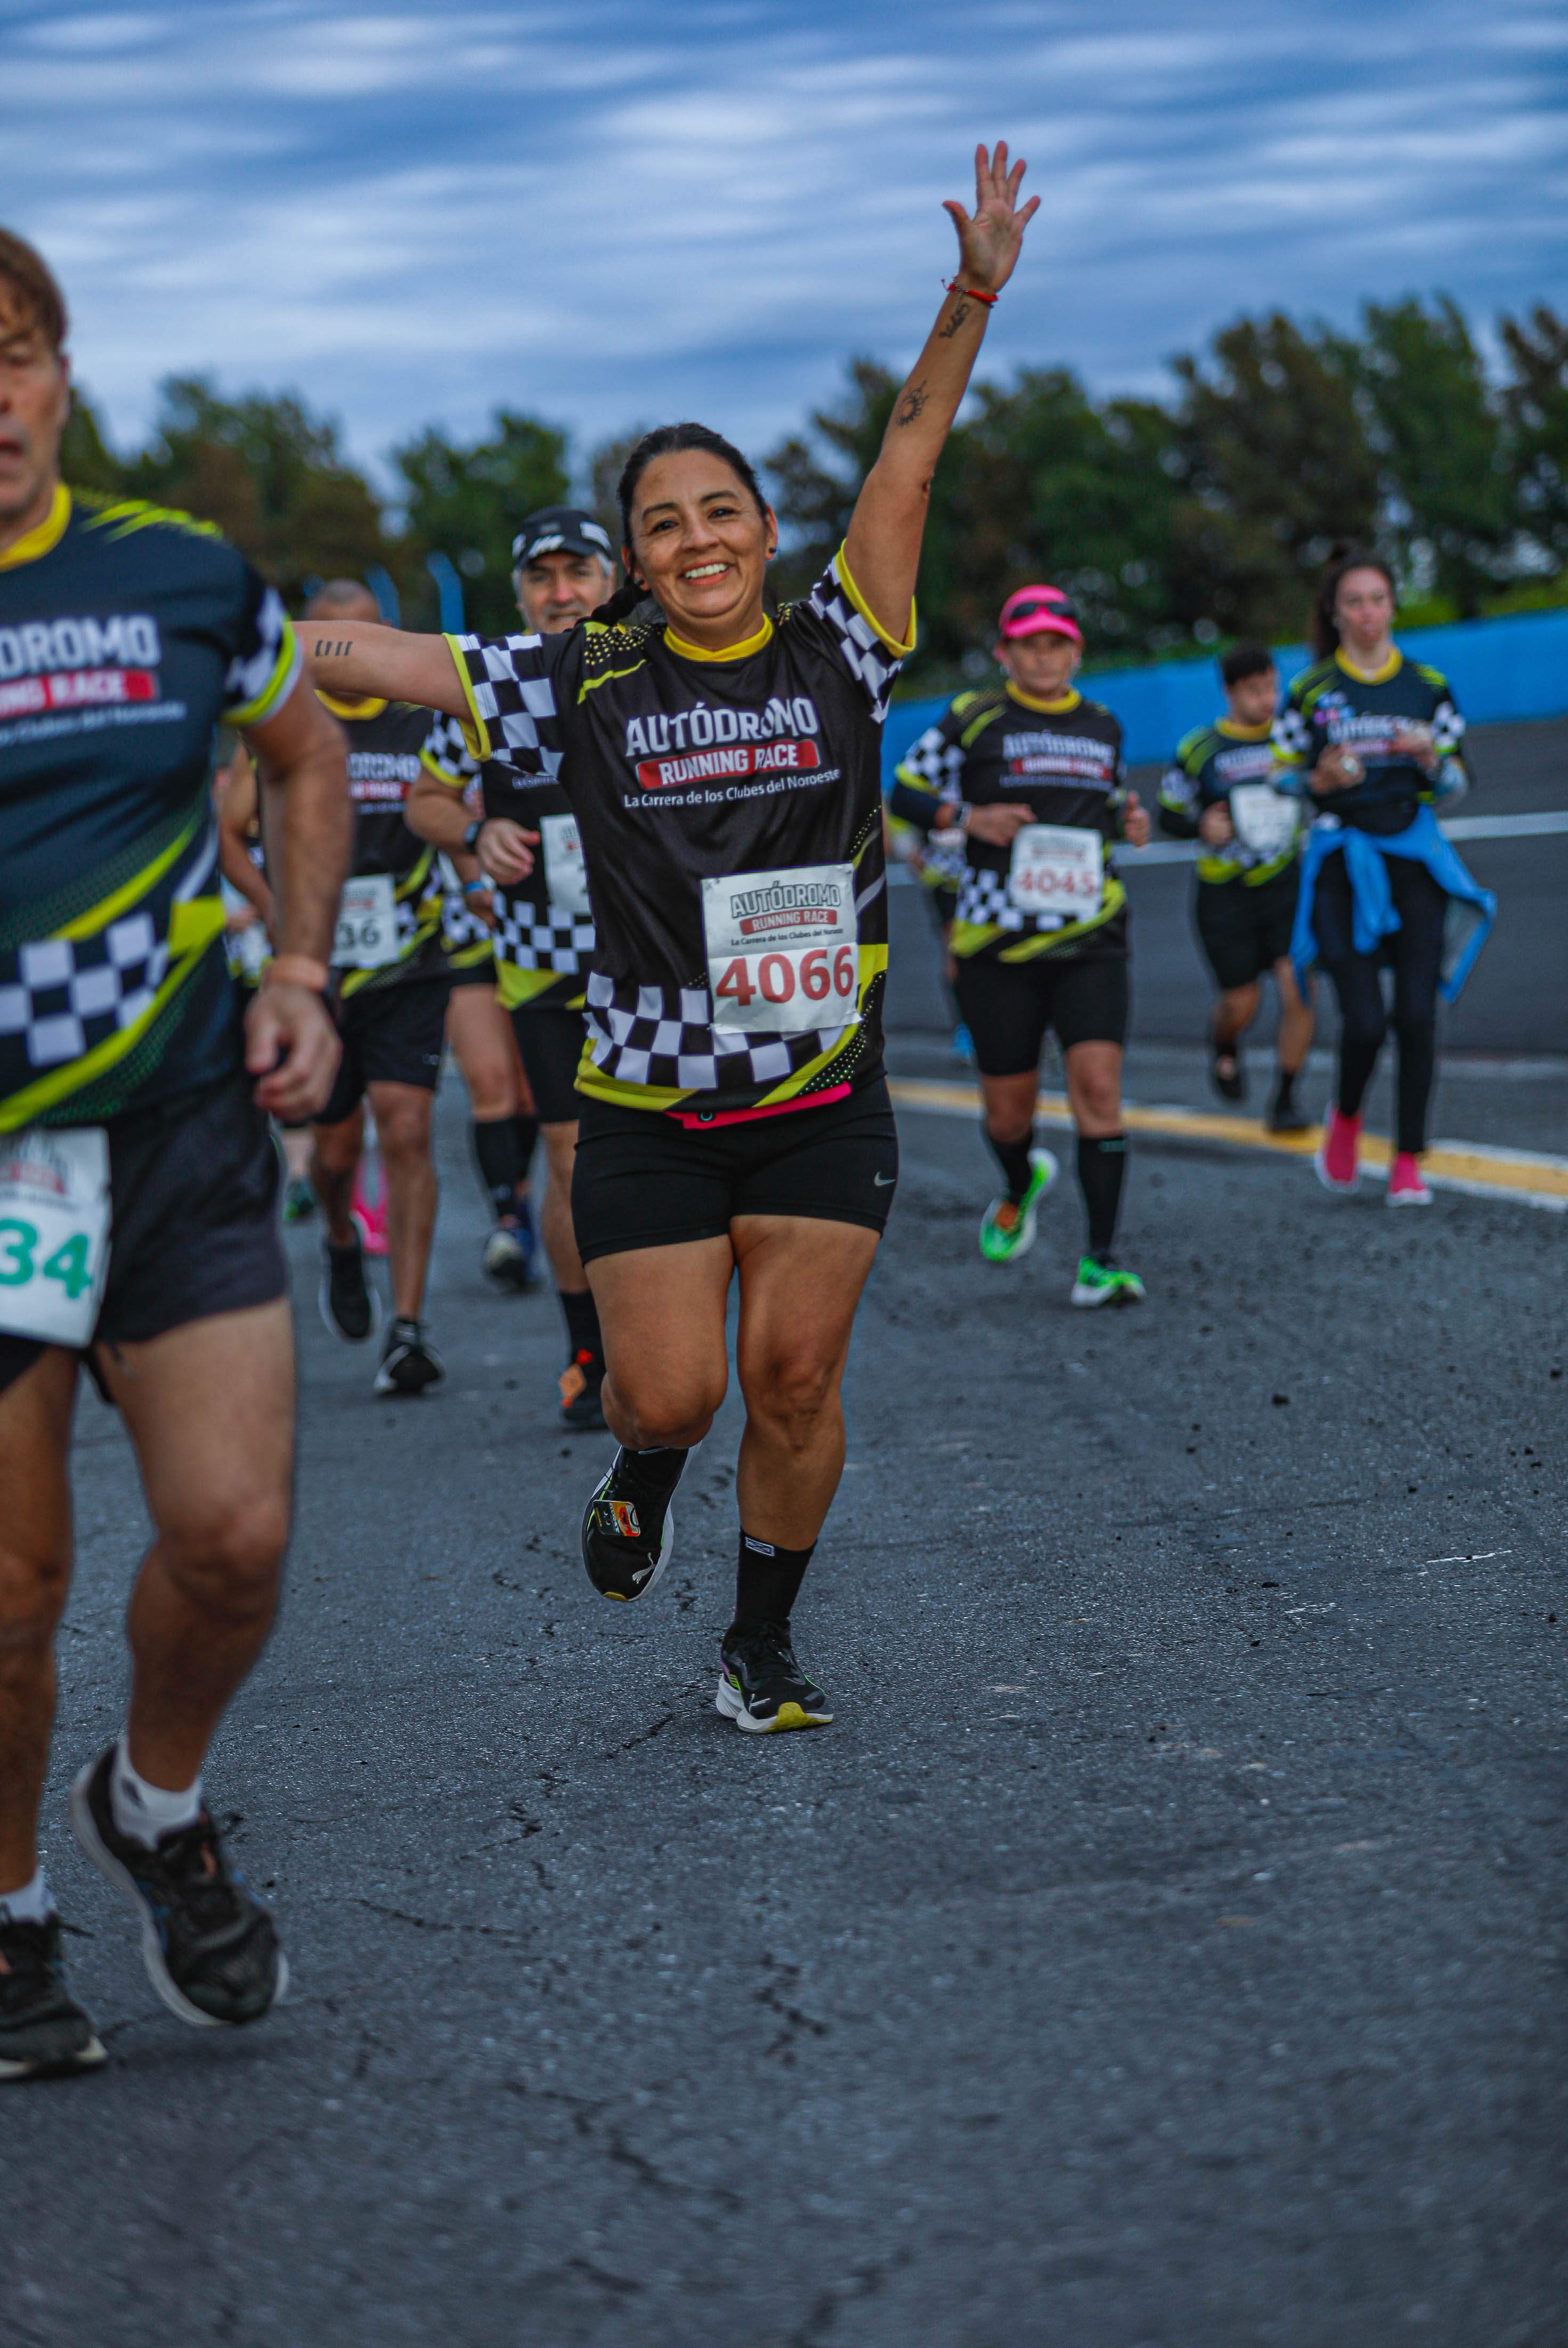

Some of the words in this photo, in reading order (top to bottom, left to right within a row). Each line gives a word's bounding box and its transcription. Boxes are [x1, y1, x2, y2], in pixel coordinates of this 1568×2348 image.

[626, 697, 819, 757] AUTÓDROMO
[659, 749, 748, 786] RUNNING
[754, 743, 799, 770] RACE
[624, 794, 639, 808] La
[641, 793, 684, 807] Carrera
[686, 790, 702, 804] de
[705, 789, 724, 802] los
[726, 784, 765, 800] Clubes
[766, 777, 786, 794] del
[787, 768, 841, 790] Noroeste
[730, 880, 841, 919] AUTÓDROMO
[741, 936, 766, 945] Carrera
[752, 911, 800, 931] RUNNING
[803, 910, 829, 923] RACE
[716, 945, 855, 1006] 4066
[0, 1218, 92, 1299] 34
